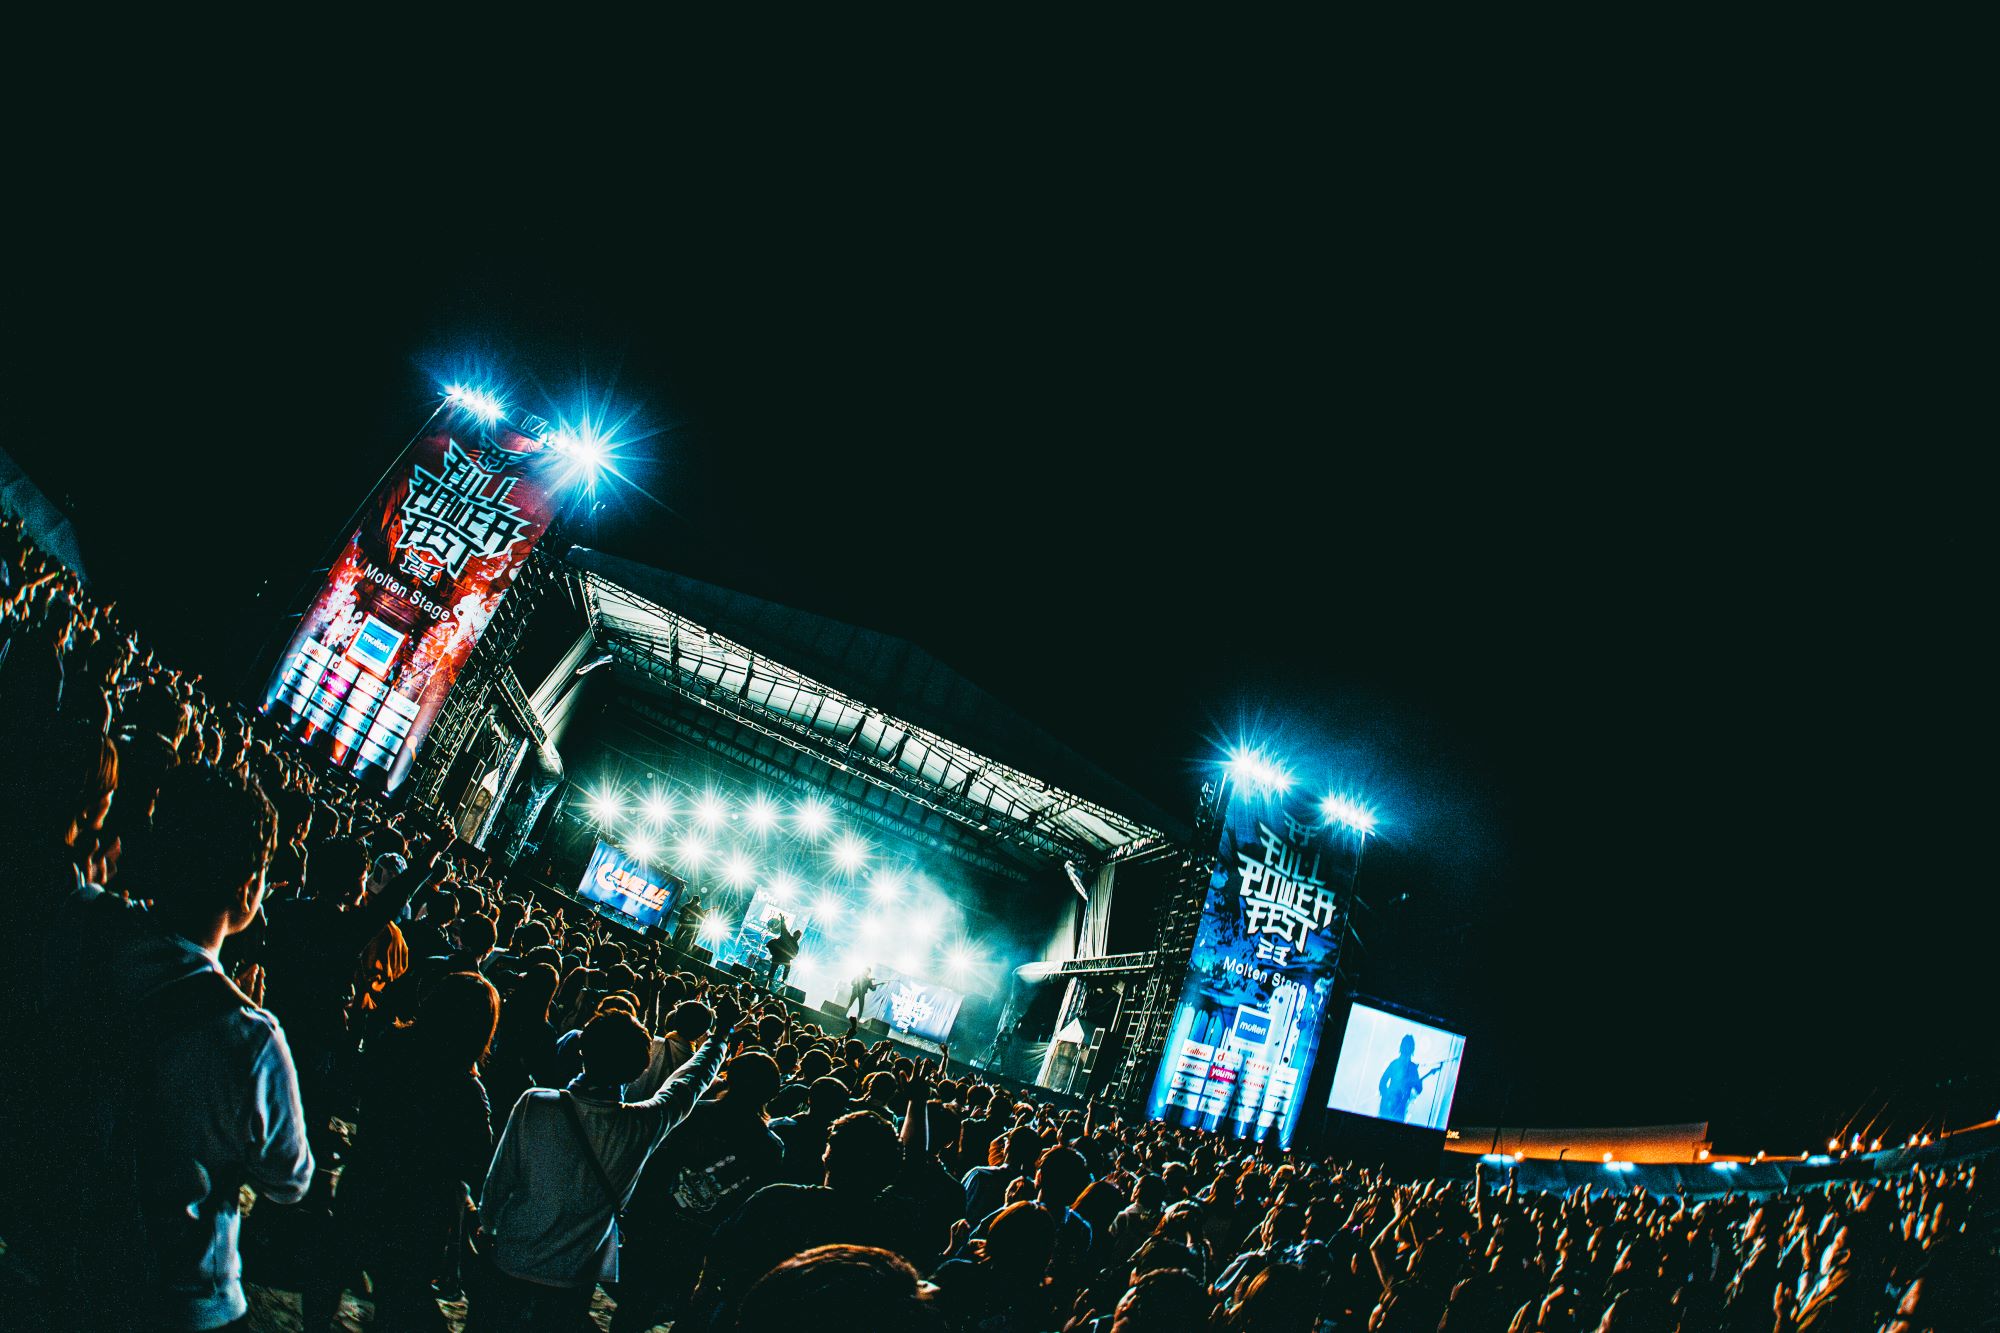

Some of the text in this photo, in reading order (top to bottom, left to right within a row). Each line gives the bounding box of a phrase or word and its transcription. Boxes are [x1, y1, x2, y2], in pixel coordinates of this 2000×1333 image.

[364, 563, 451, 620] Molten Stage
[1237, 851, 1336, 928] POWER
[1245, 897, 1319, 953] FEST
[1223, 956, 1268, 983] Molten
[1239, 1021, 1267, 1036] molten
